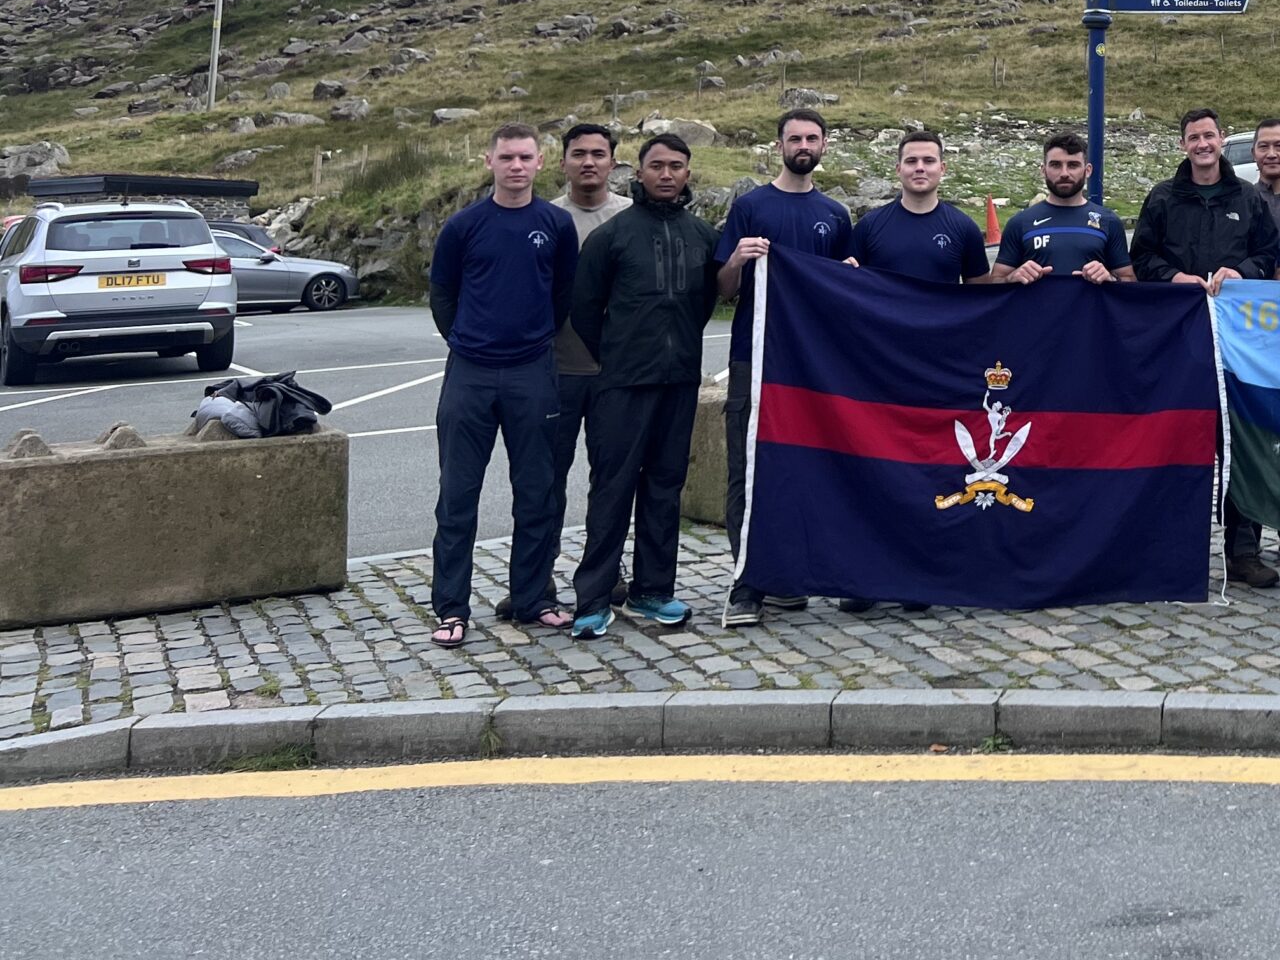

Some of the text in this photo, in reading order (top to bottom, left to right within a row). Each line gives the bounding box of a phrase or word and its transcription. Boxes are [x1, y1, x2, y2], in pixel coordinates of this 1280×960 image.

[1174, 0, 1209, 7] Toiledau
[1214, 0, 1242, 7] Toilets
[1033, 235, 1050, 249] DF
[106, 274, 160, 287] DL17 FTU
[1239, 300, 1280, 332] 16
